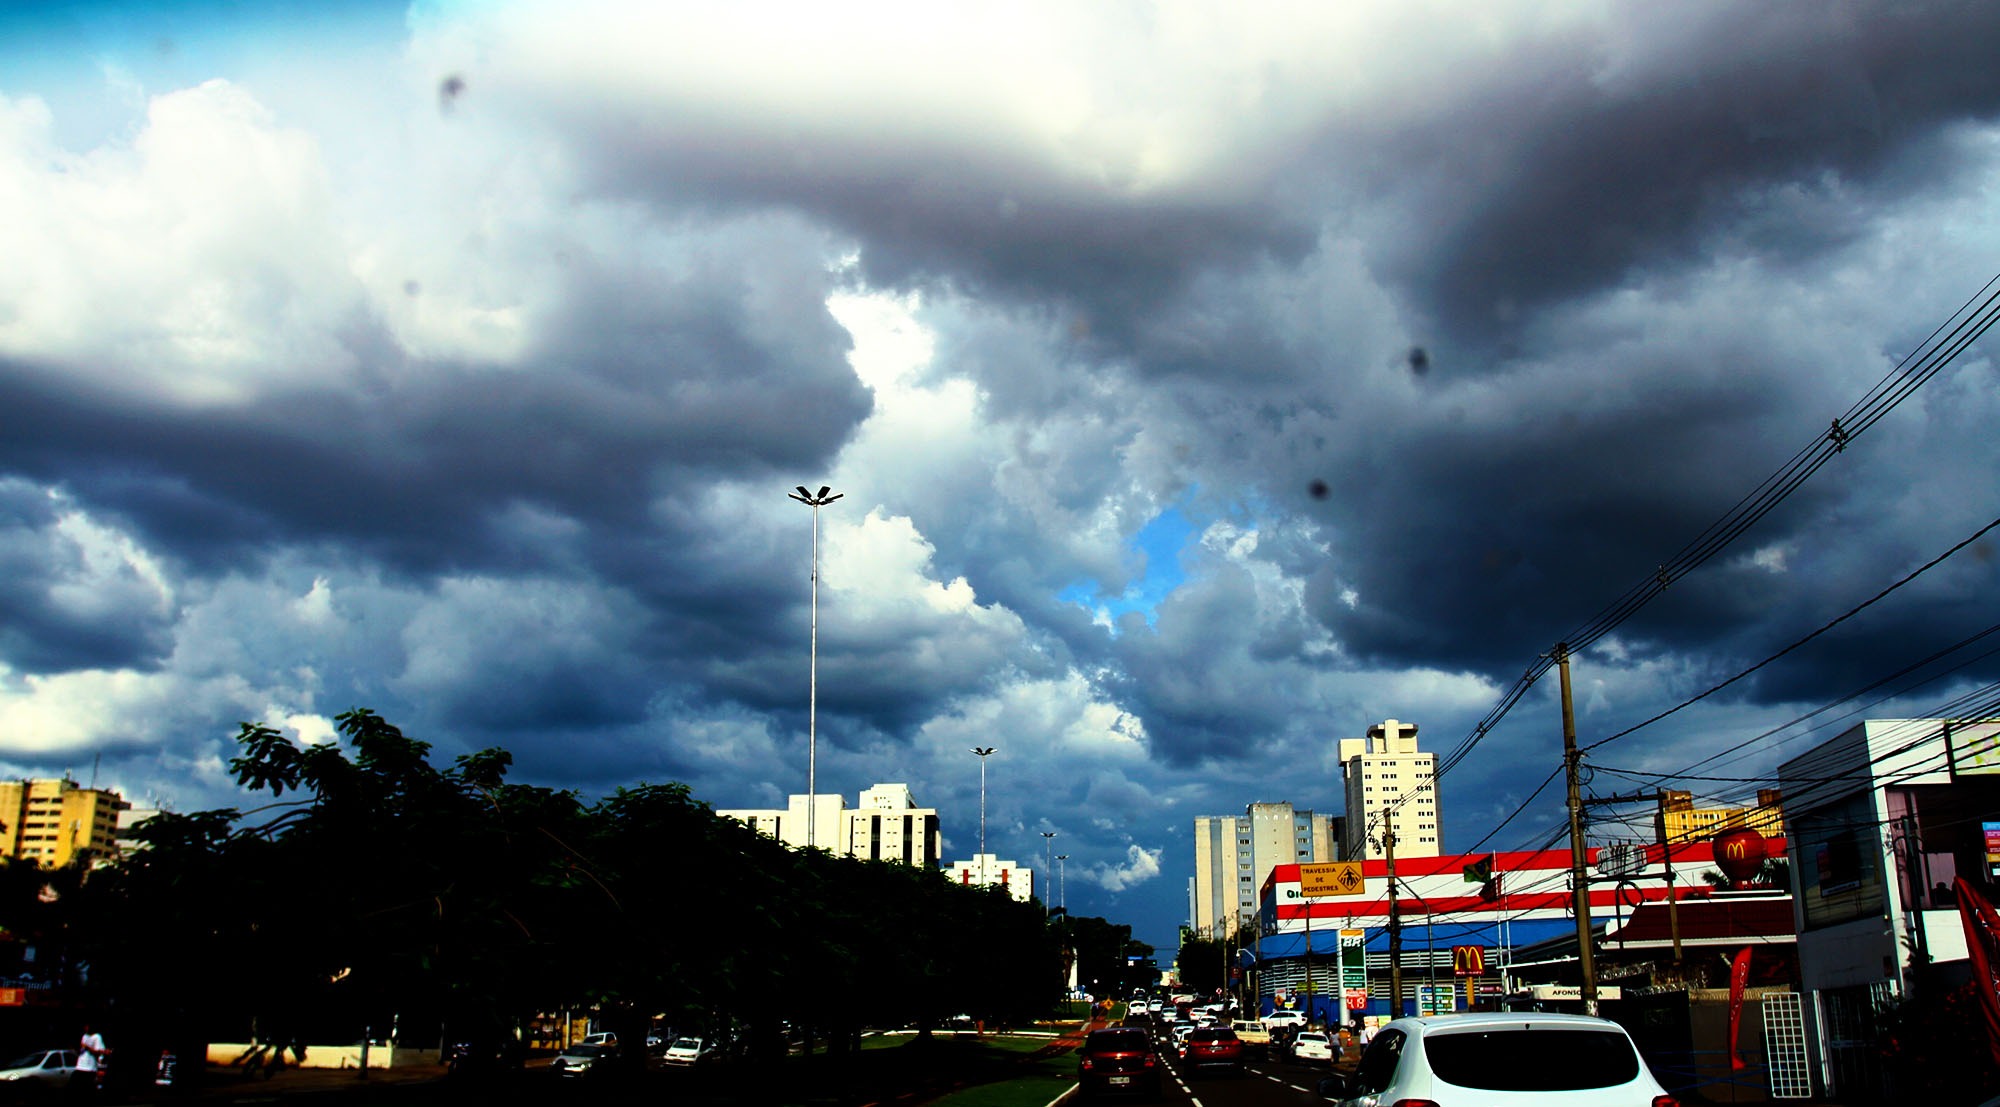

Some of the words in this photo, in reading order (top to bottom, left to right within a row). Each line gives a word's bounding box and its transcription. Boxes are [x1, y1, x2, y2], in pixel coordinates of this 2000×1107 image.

[1302, 867, 1336, 875] TRAVESSIA
[1303, 885, 1339, 893] PEDESTRES
[1342, 937, 1362, 948] BR
